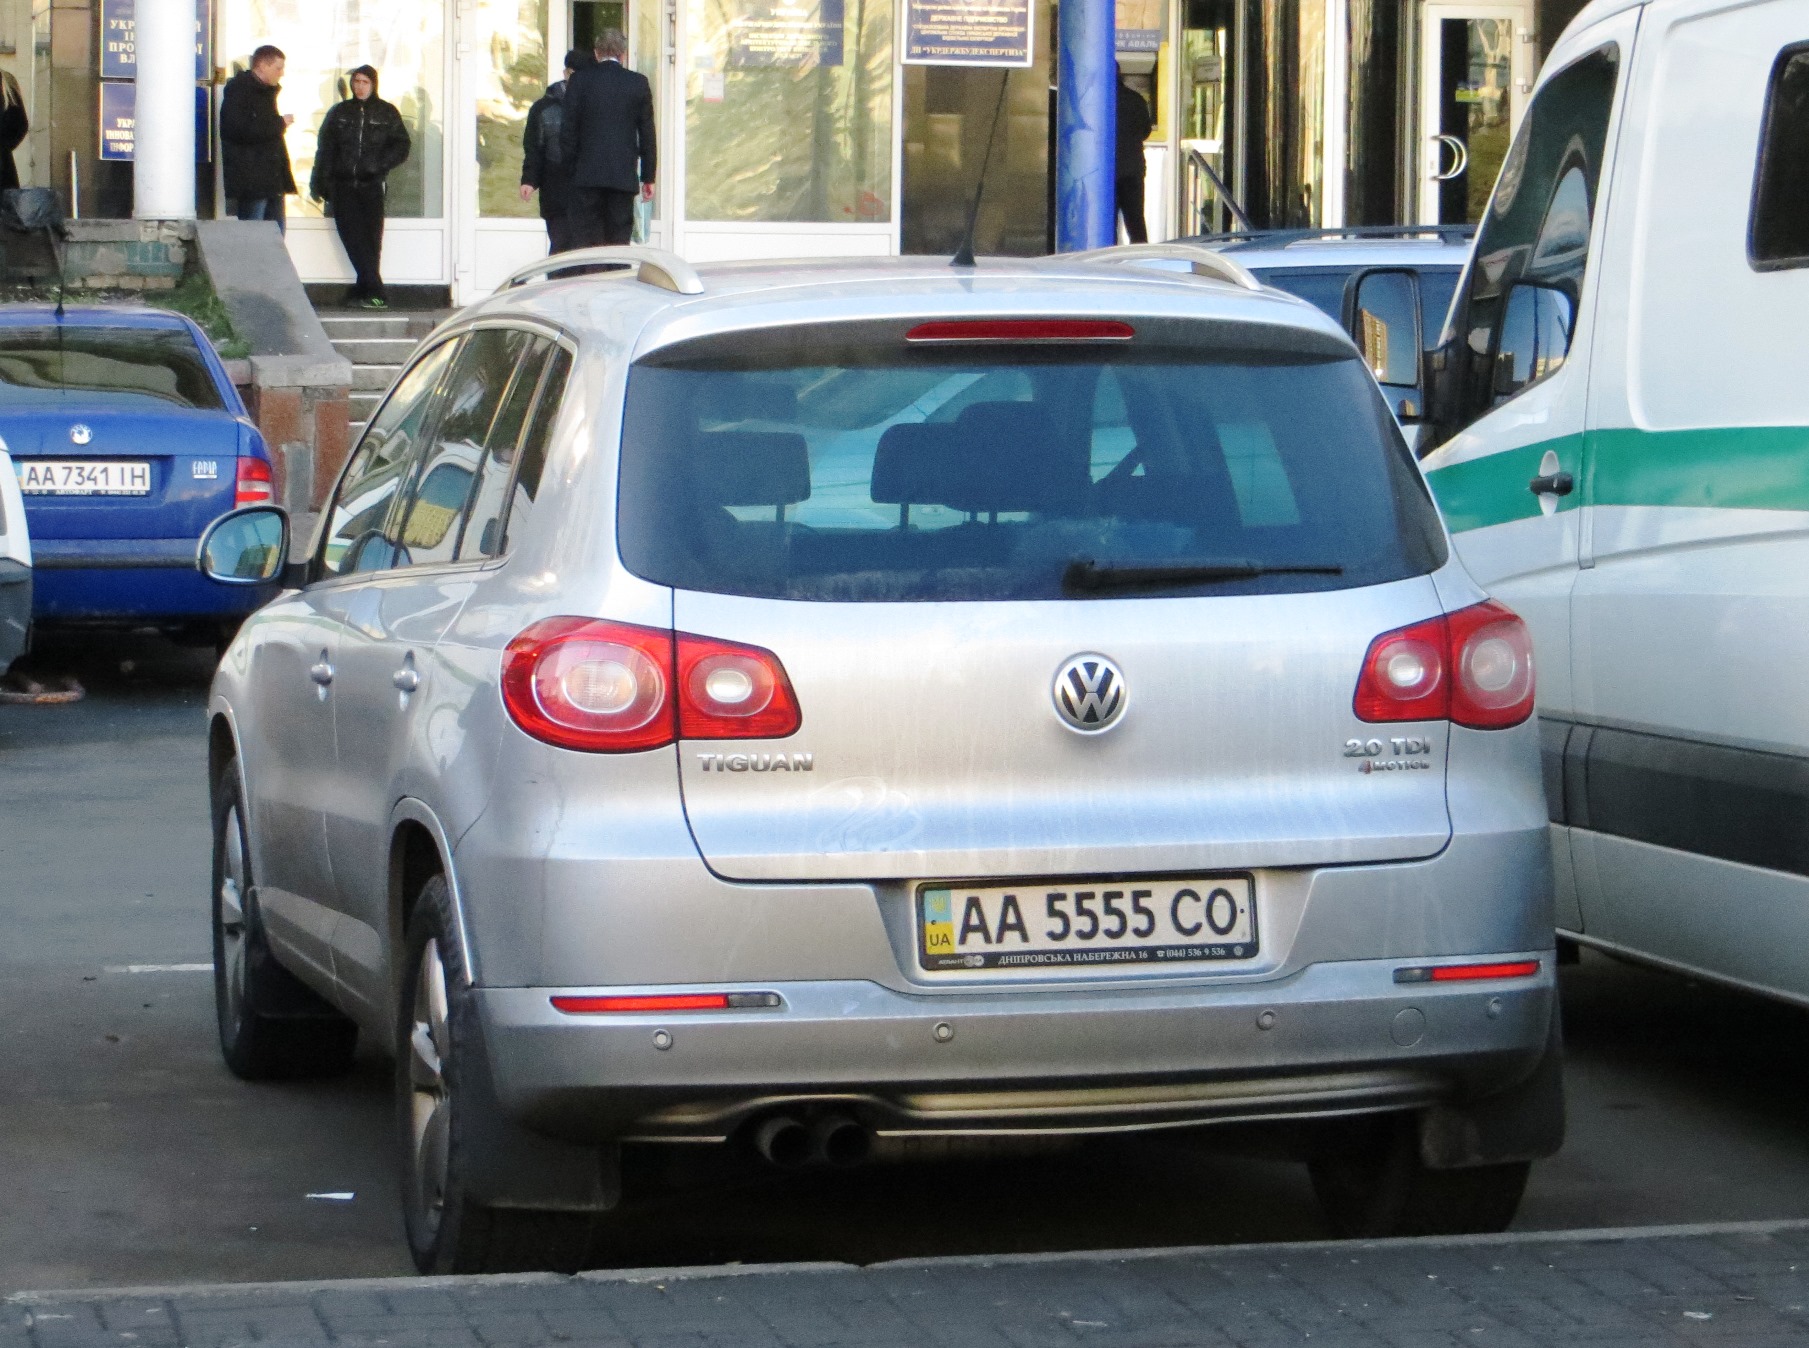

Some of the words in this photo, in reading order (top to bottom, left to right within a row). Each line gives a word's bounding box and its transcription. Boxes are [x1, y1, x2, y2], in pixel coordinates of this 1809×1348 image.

[105, 129, 135, 140] ІННОВА
[26, 466, 56, 486] AA
[61, 466, 109, 486] 7341
[120, 466, 146, 487] IH
[1390, 737, 1431, 756] TDI
[696, 753, 813, 772] TIGUAN
[958, 894, 1030, 945] AA
[1045, 889, 1156, 941] 5555
[1170, 887, 1238, 937] CO
[929, 933, 951, 947] UA
[998, 953, 1072, 965] ДНІПРОВСЬКА
[1073, 951, 1137, 962] НАБЕРЕЖНА
[1138, 950, 1148, 959] 16
[1166, 948, 1186, 958] (044)
[1187, 948, 1202, 957] 536
[1211, 947, 1226, 956] 536
